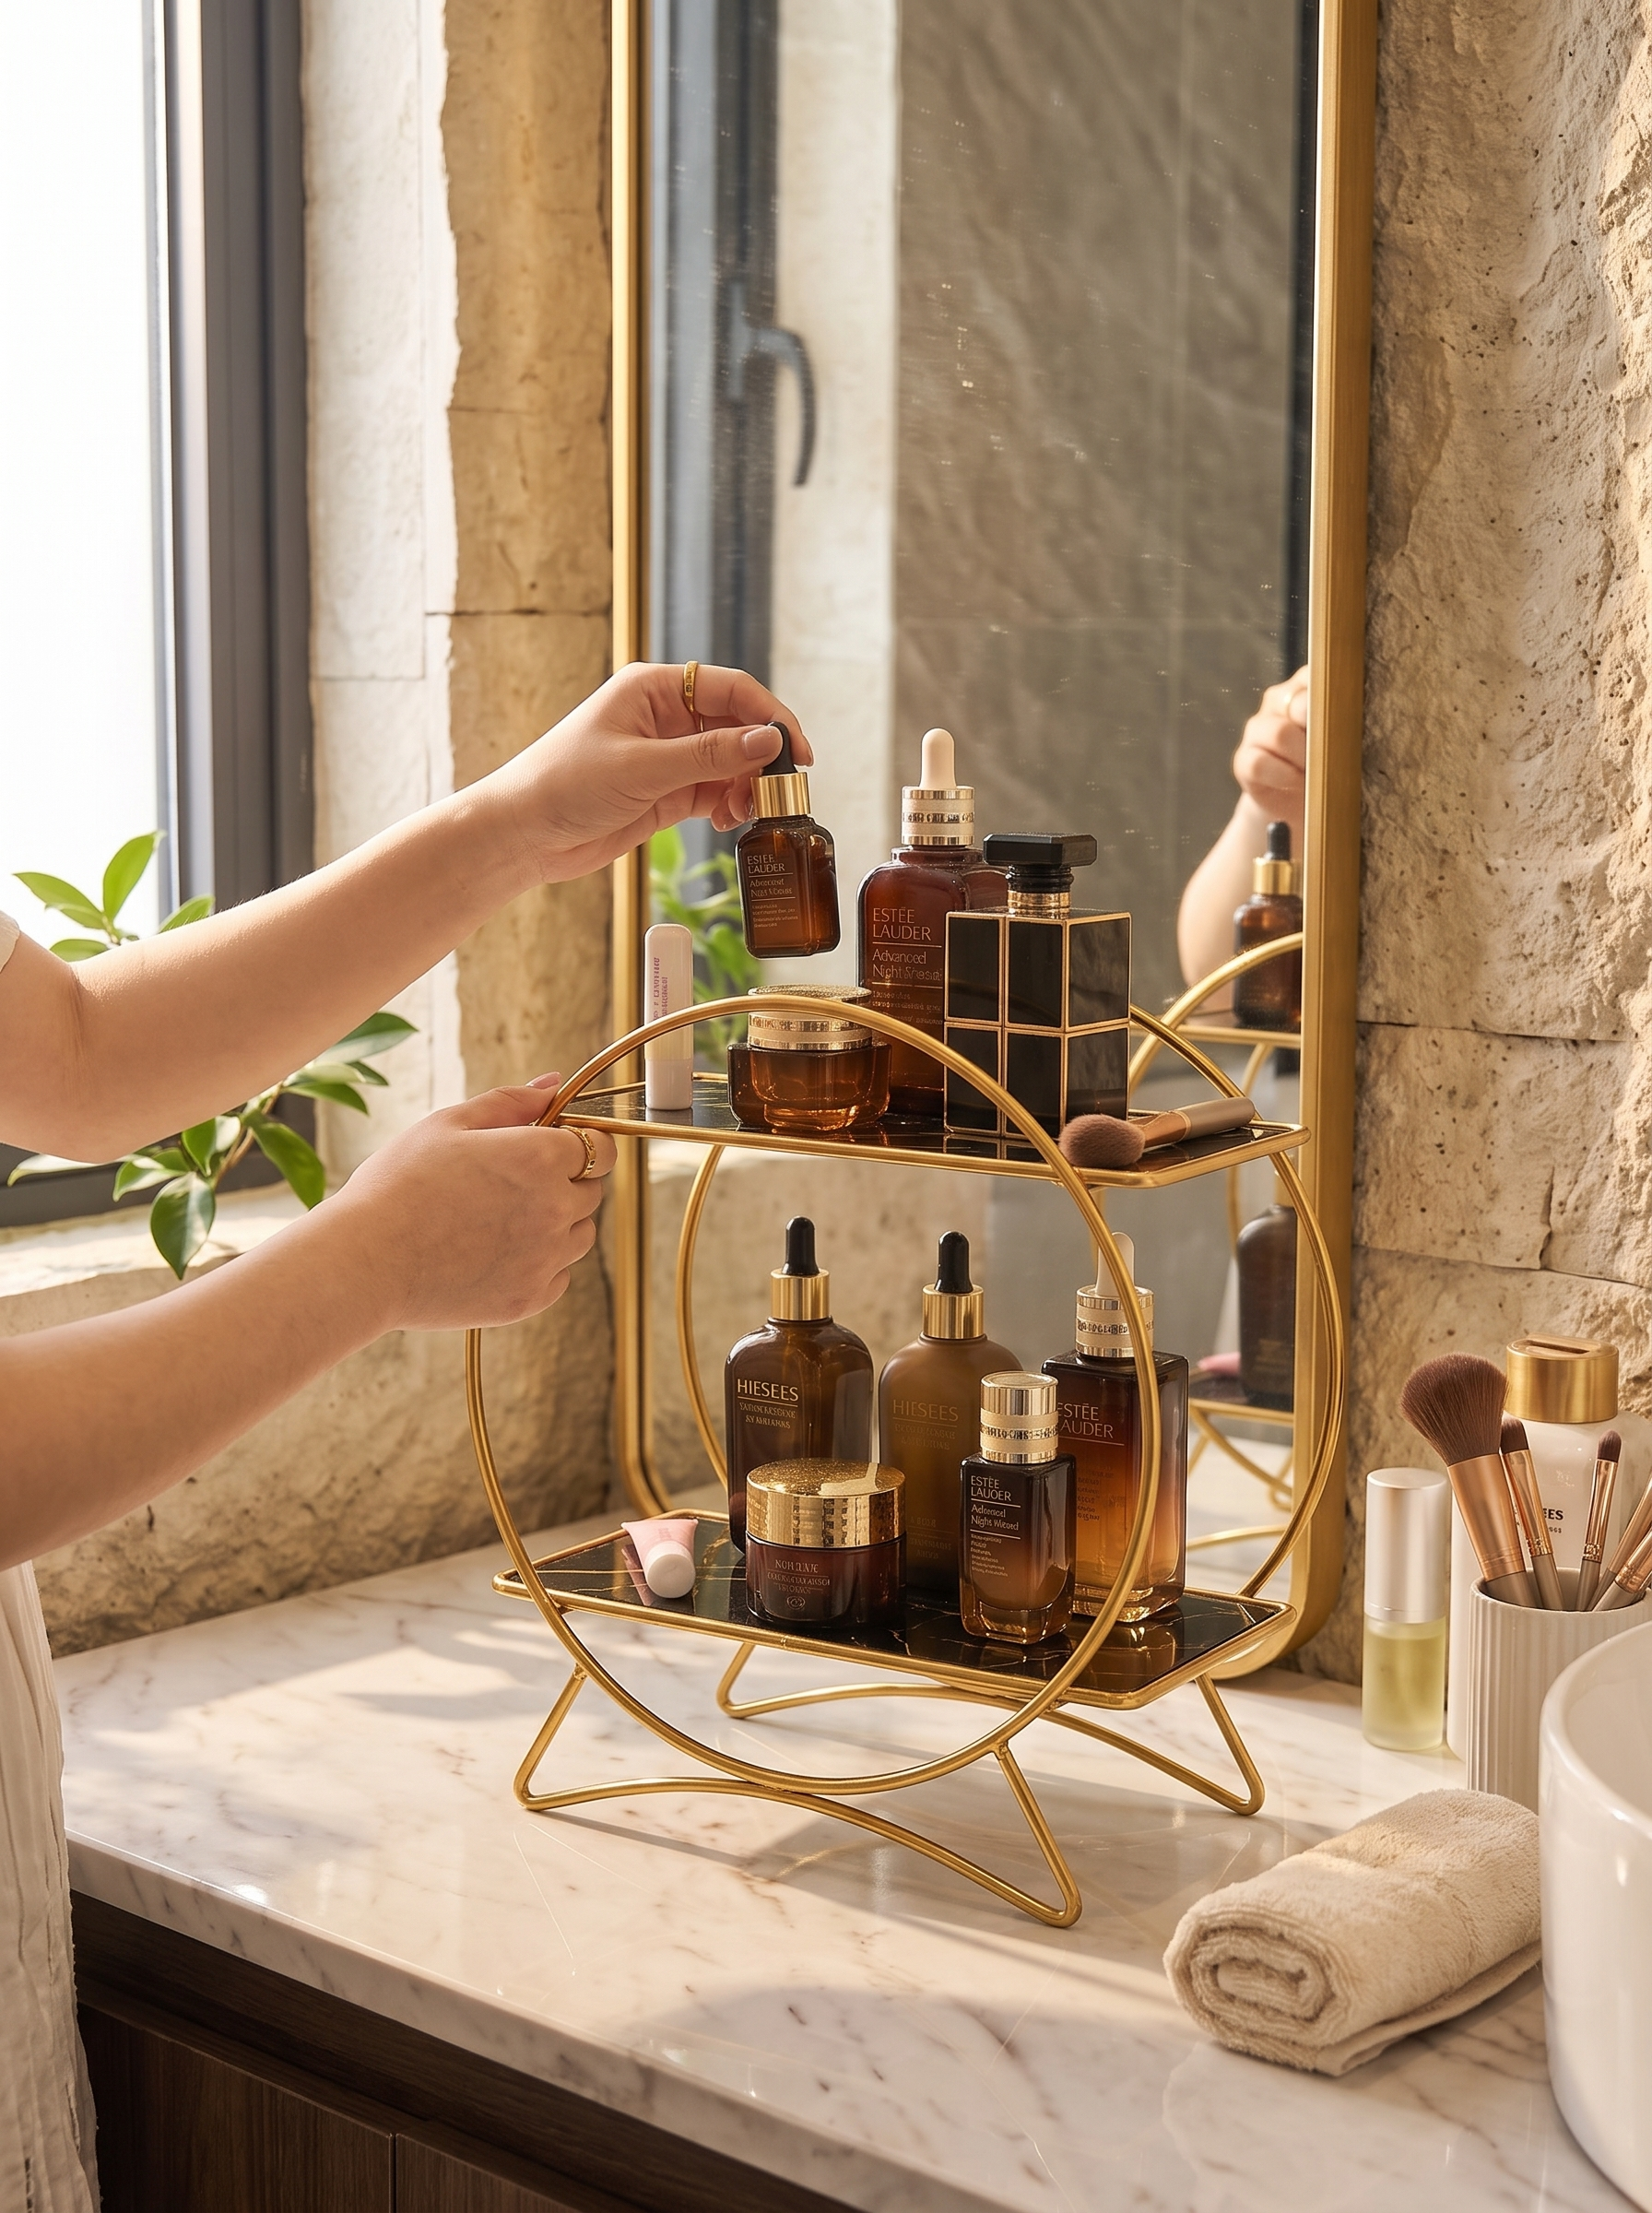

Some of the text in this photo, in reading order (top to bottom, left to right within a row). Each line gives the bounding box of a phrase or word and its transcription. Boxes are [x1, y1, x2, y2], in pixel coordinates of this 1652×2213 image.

[873, 924, 931, 941] LAUDER
[738, 1379, 798, 1402] HIESEES
[893, 1399, 959, 1422] HIESEES
[1060, 1419, 1114, 1438] AUDER
